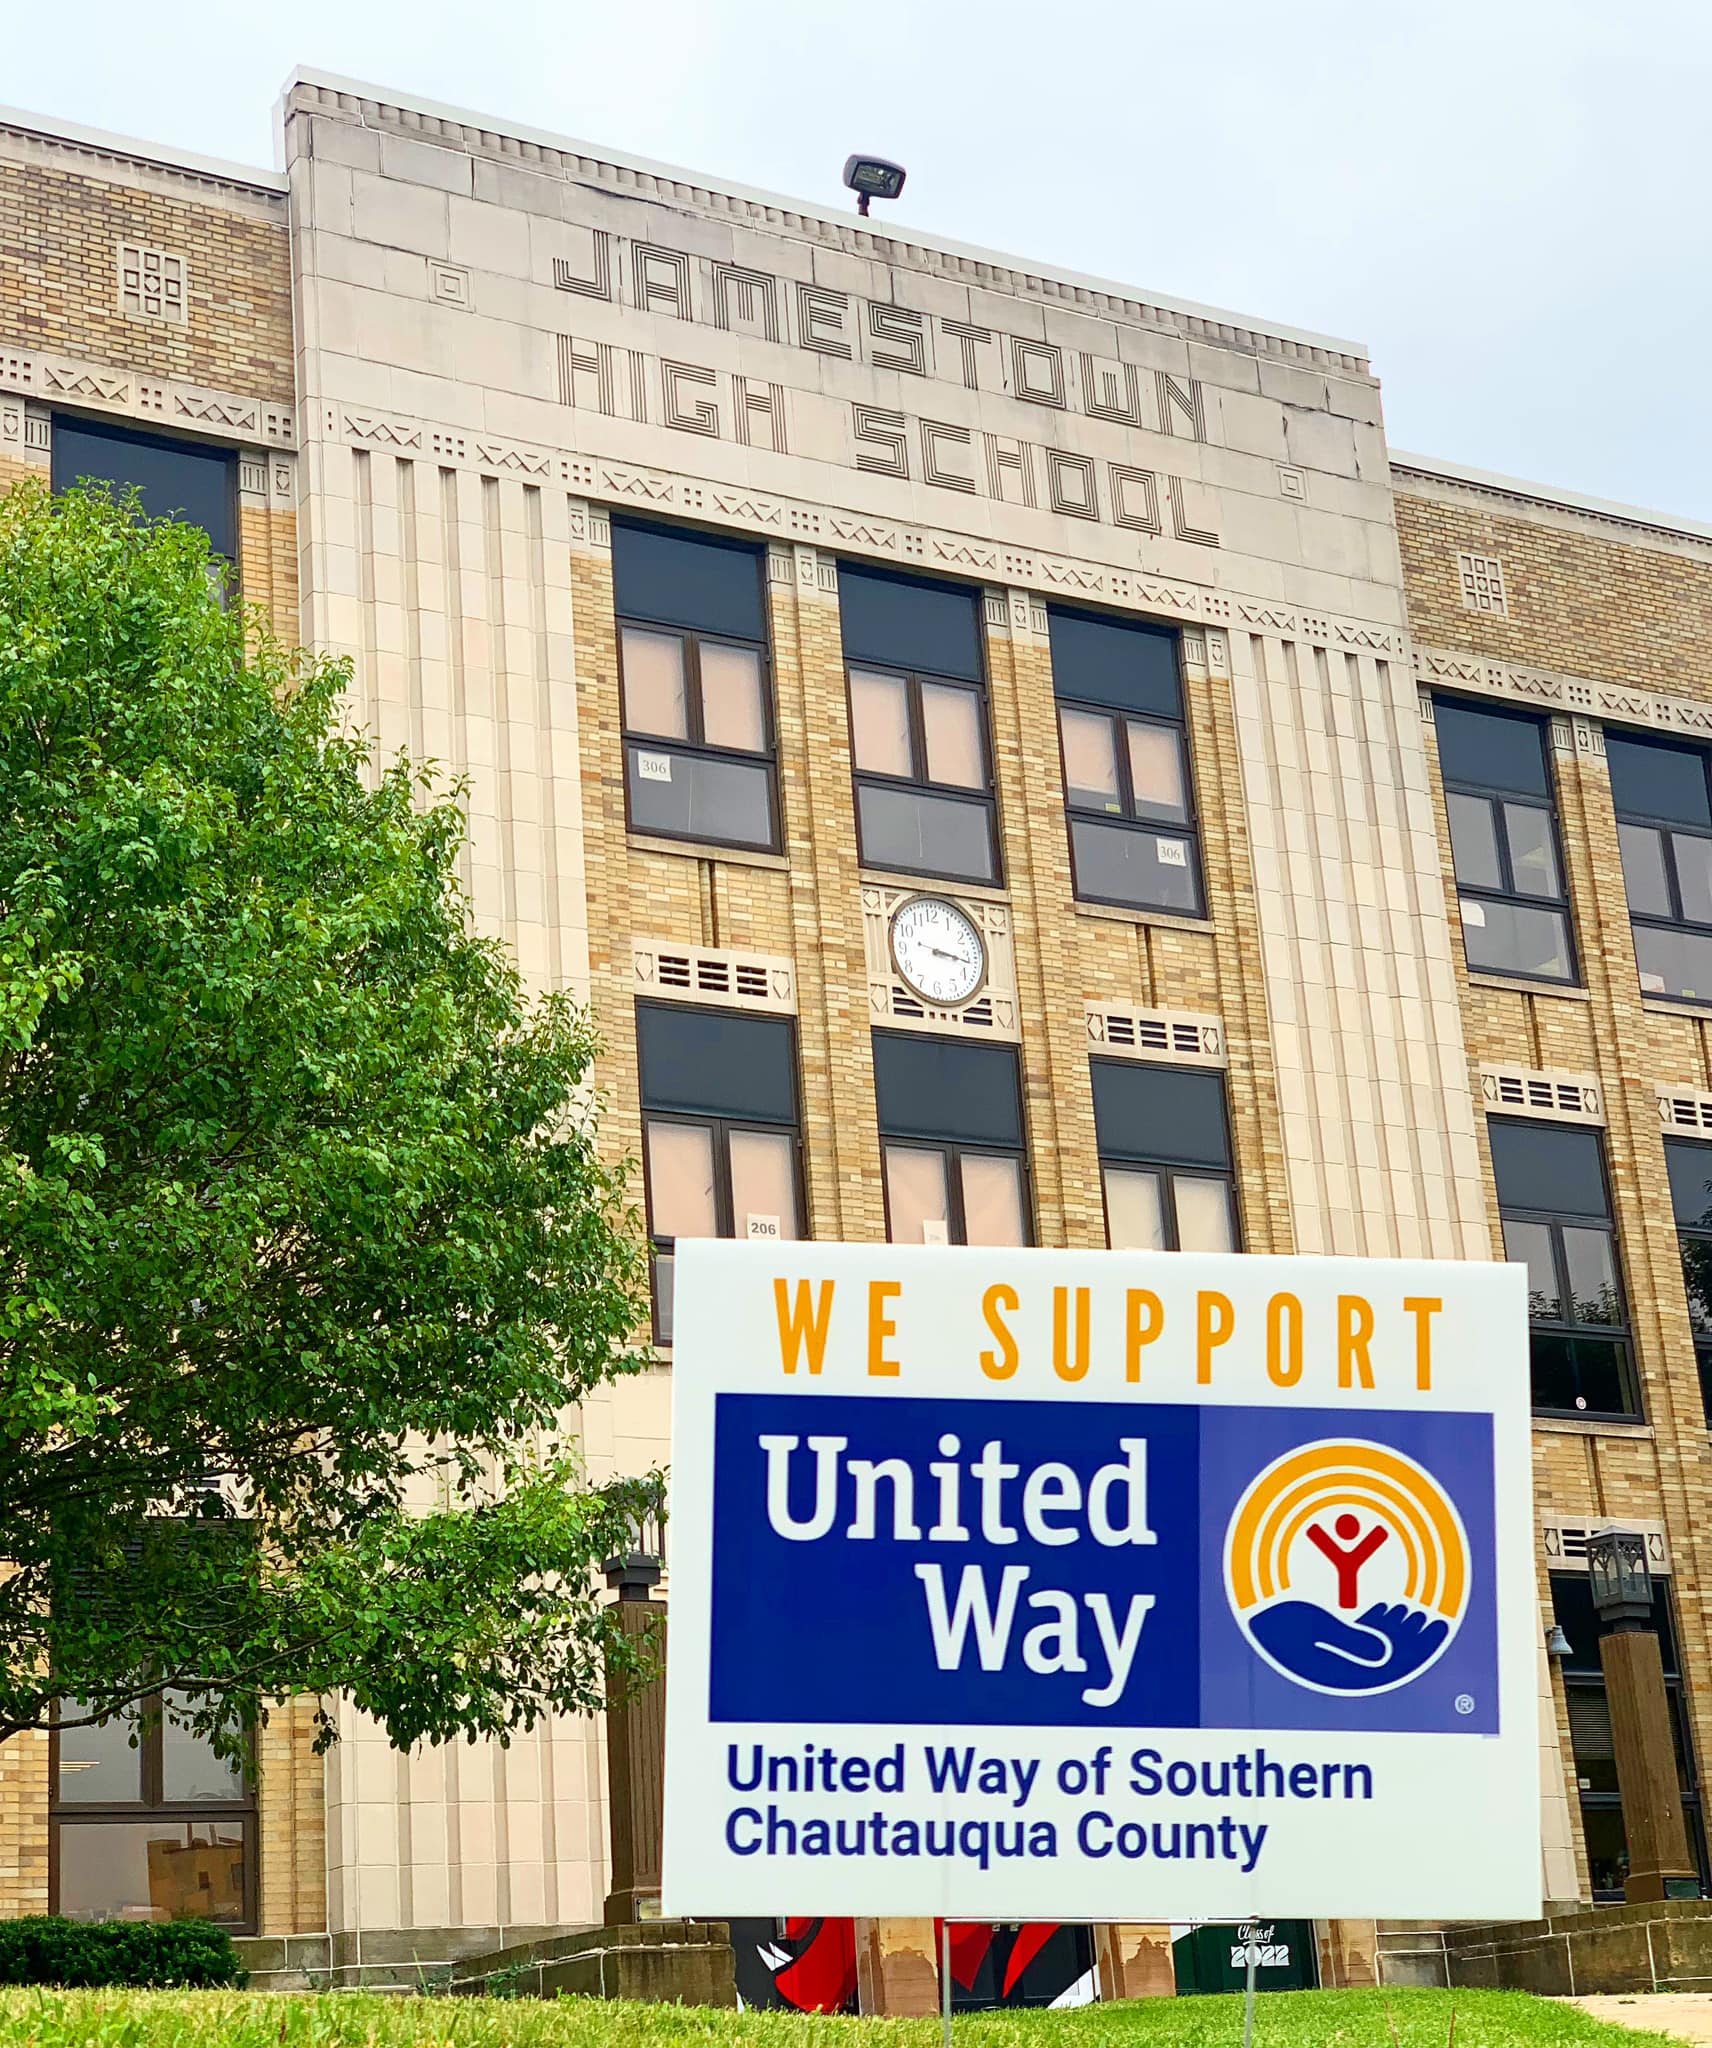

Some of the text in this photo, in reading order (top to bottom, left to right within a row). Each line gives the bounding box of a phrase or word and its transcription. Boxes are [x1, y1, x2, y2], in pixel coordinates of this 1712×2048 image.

[552, 230, 1207, 443] JAMESTOWN
[557, 333, 1220, 548] HIGH SCHOOL
[643, 759, 666, 774] 306
[1160, 846, 1181, 860] 306
[913, 911, 923, 927] 11
[926, 908, 939, 924] 12
[901, 923, 914, 938] 10
[957, 931, 966, 945] 2
[899, 941, 907, 955] 9
[904, 959, 913, 974] 8
[917, 974, 925, 988] 7
[933, 981, 942, 995] 6
[949, 978, 958, 993] 5
[751, 1222, 776, 1235] 206
[773, 1278, 1444, 1391] WE SUPPORT
[759, 1434, 1157, 1547] United
[914, 1563, 1155, 1707] Way
[727, 1743, 1374, 1808] United Way of Southern
[725, 1804, 1269, 1873] Chautauqua County
[1237, 1925, 1264, 1940] Clss
[1230, 1945, 1290, 1968] 2022
